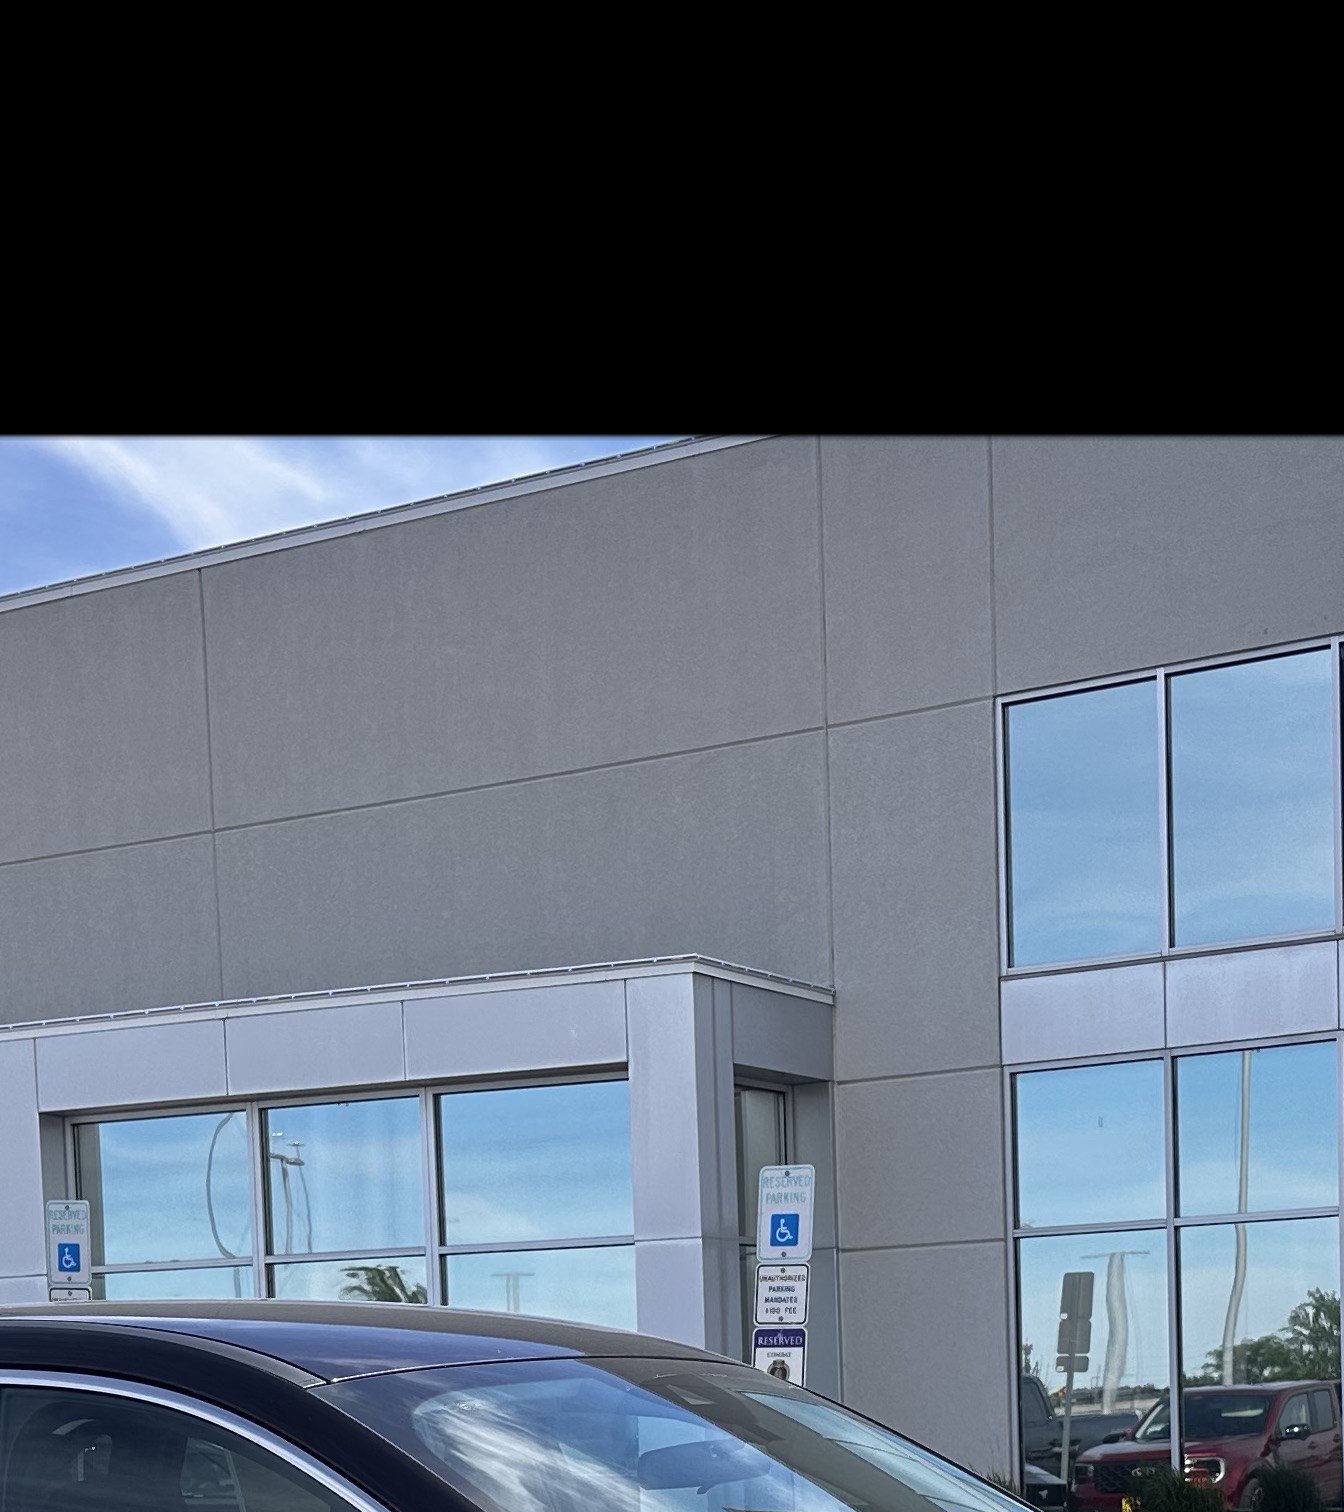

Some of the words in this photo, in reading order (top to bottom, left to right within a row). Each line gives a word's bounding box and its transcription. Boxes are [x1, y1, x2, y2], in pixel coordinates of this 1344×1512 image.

[762, 1175, 811, 1189] RESERVED
[765, 1192, 807, 1205] PARKING
[52, 1223, 85, 1235] PARKING
[768, 1285, 796, 1293] PARKING
[757, 1335, 803, 1346] RESERVED
